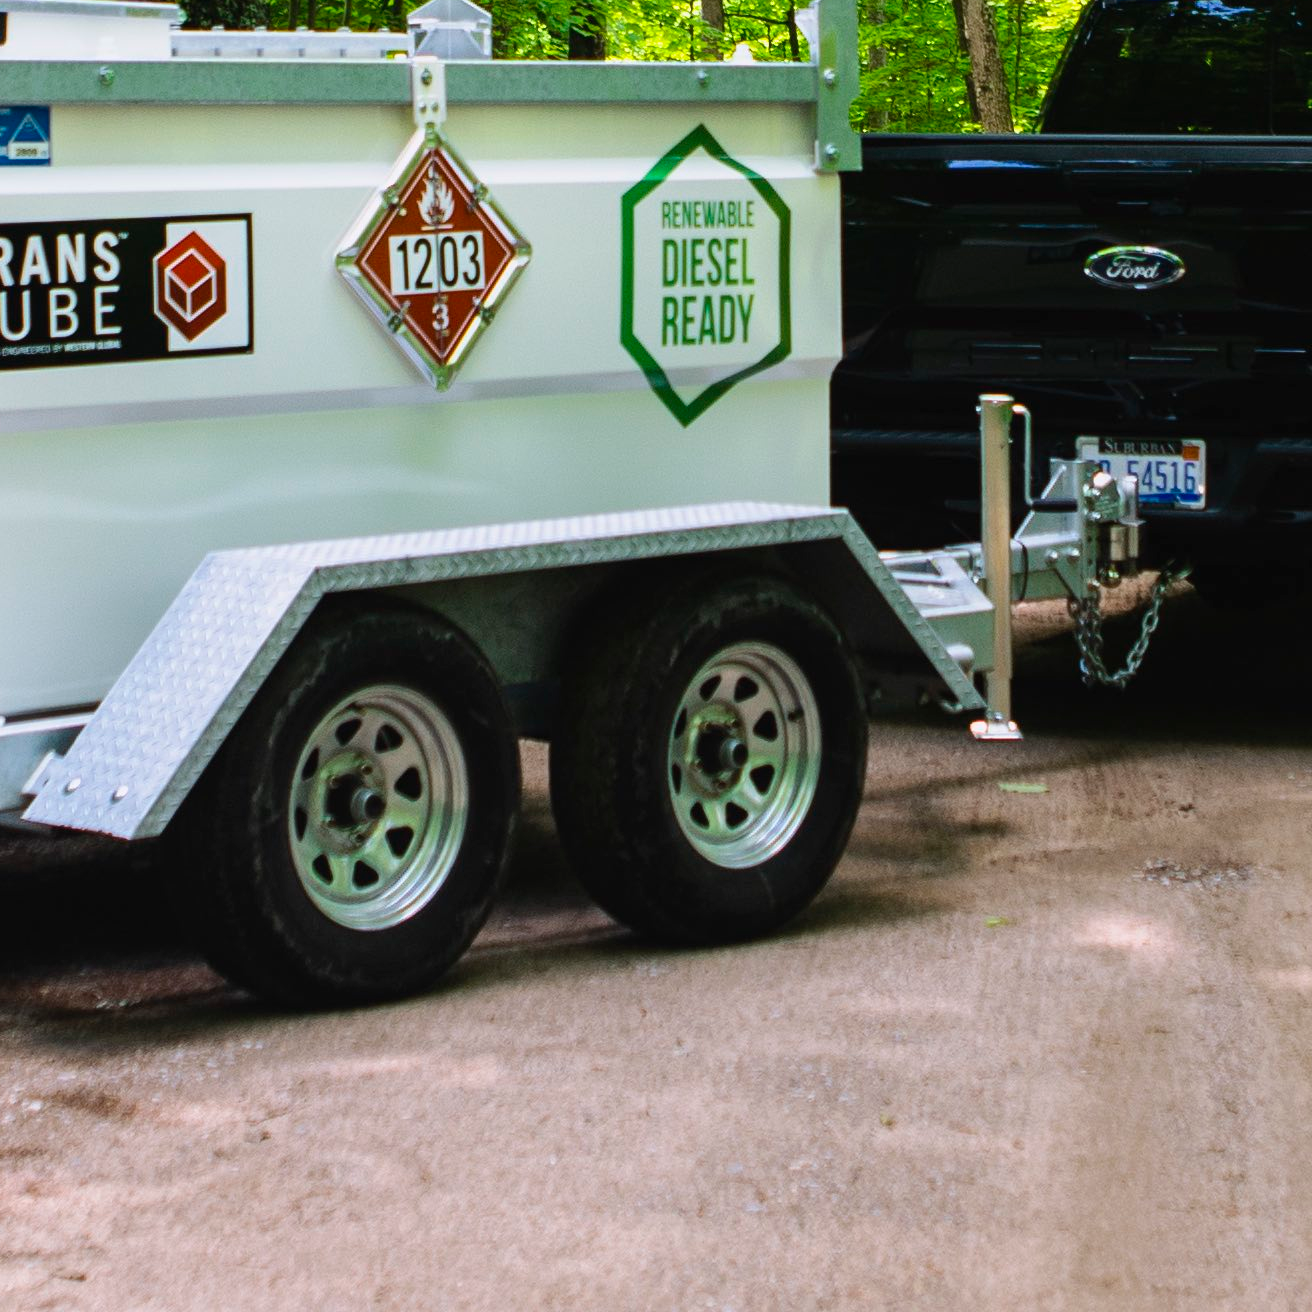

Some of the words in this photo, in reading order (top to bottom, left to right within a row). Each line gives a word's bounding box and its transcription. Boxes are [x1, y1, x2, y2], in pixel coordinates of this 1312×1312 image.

[662, 200, 755, 229] RENEWABLE
[396, 235, 481, 290] 1203
[662, 238, 755, 287] DIESEL
[1106, 255, 1161, 279] Ford
[432, 303, 449, 331] 3
[662, 294, 755, 347] READY
[1104, 438, 1178, 455] SUBURBAN
[1127, 461, 1196, 493] 54516
